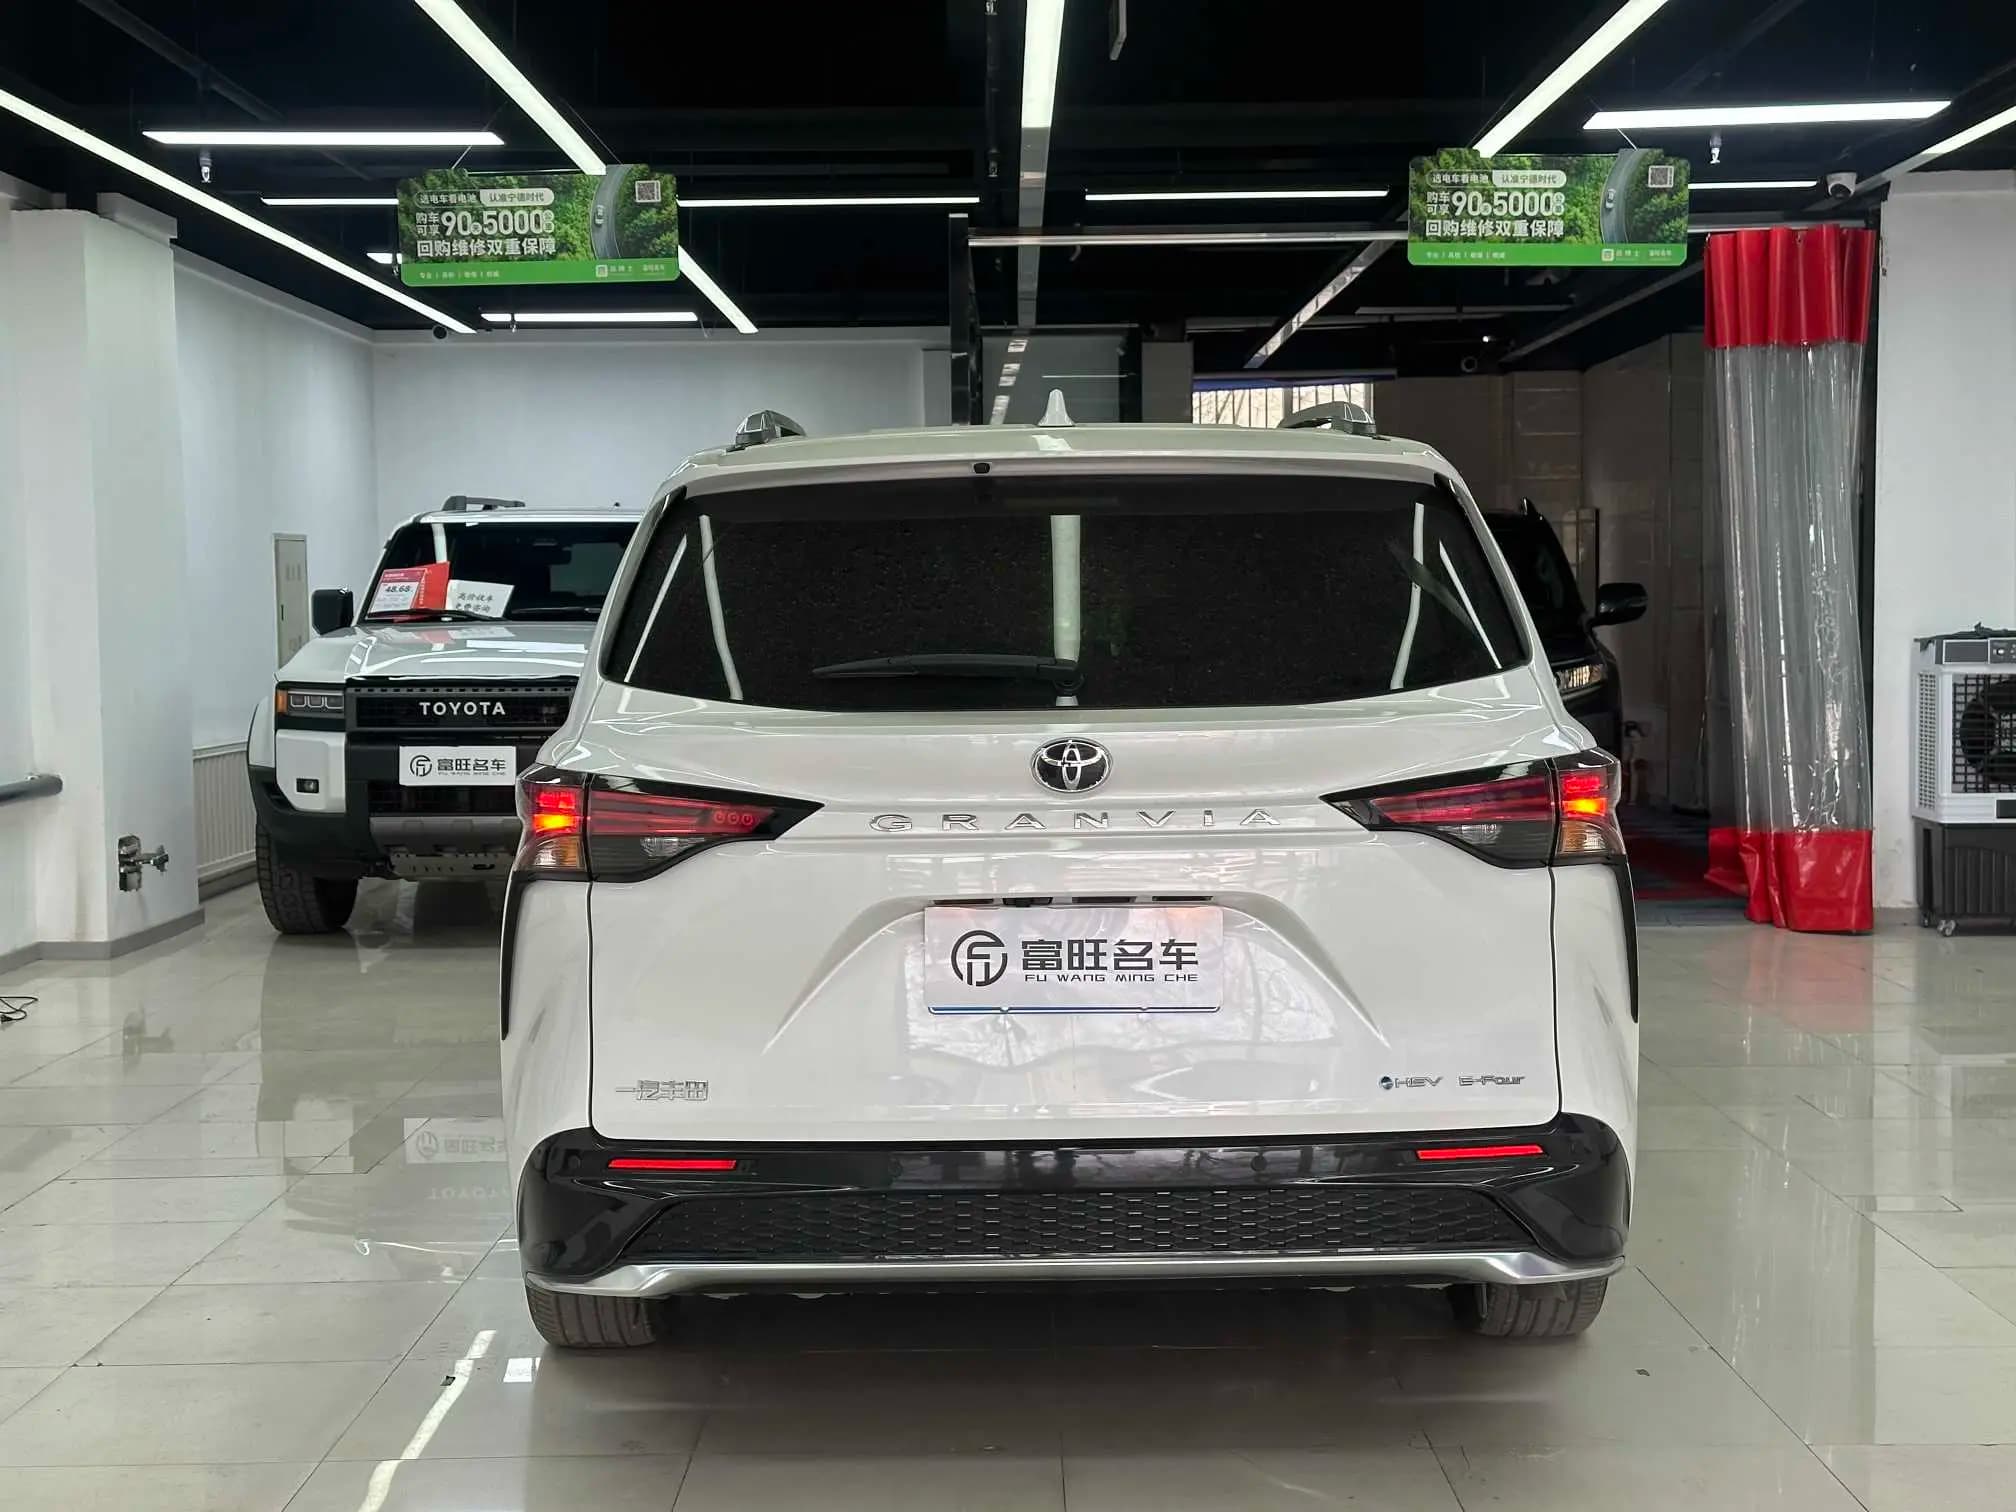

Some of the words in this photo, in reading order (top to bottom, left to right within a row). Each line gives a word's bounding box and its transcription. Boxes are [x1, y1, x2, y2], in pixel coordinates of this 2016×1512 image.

[1501, 173, 1558, 185] 认准宁德时代
[1426, 191, 1450, 203] 购车
[1426, 203, 1450, 216] 可享
[415, 212, 440, 224] 购车
[416, 224, 440, 237] 可享
[1425, 219, 1565, 238] 回购维修双重保障
[416, 236, 557, 257] 回购维修双重保障
[419, 701, 506, 716] TOYOTA
[437, 758, 507, 772] 富旺名车
[868, 808, 1282, 832] GRANVIA
[1021, 938, 1199, 971] 富旺名车
[1025, 973, 1048, 982] FU
[1057, 973, 1105, 982] WANG
[1115, 973, 1155, 982] MING
[1164, 973, 1199, 982] CHE
[615, 1079, 709, 1102] 一汽丰田
